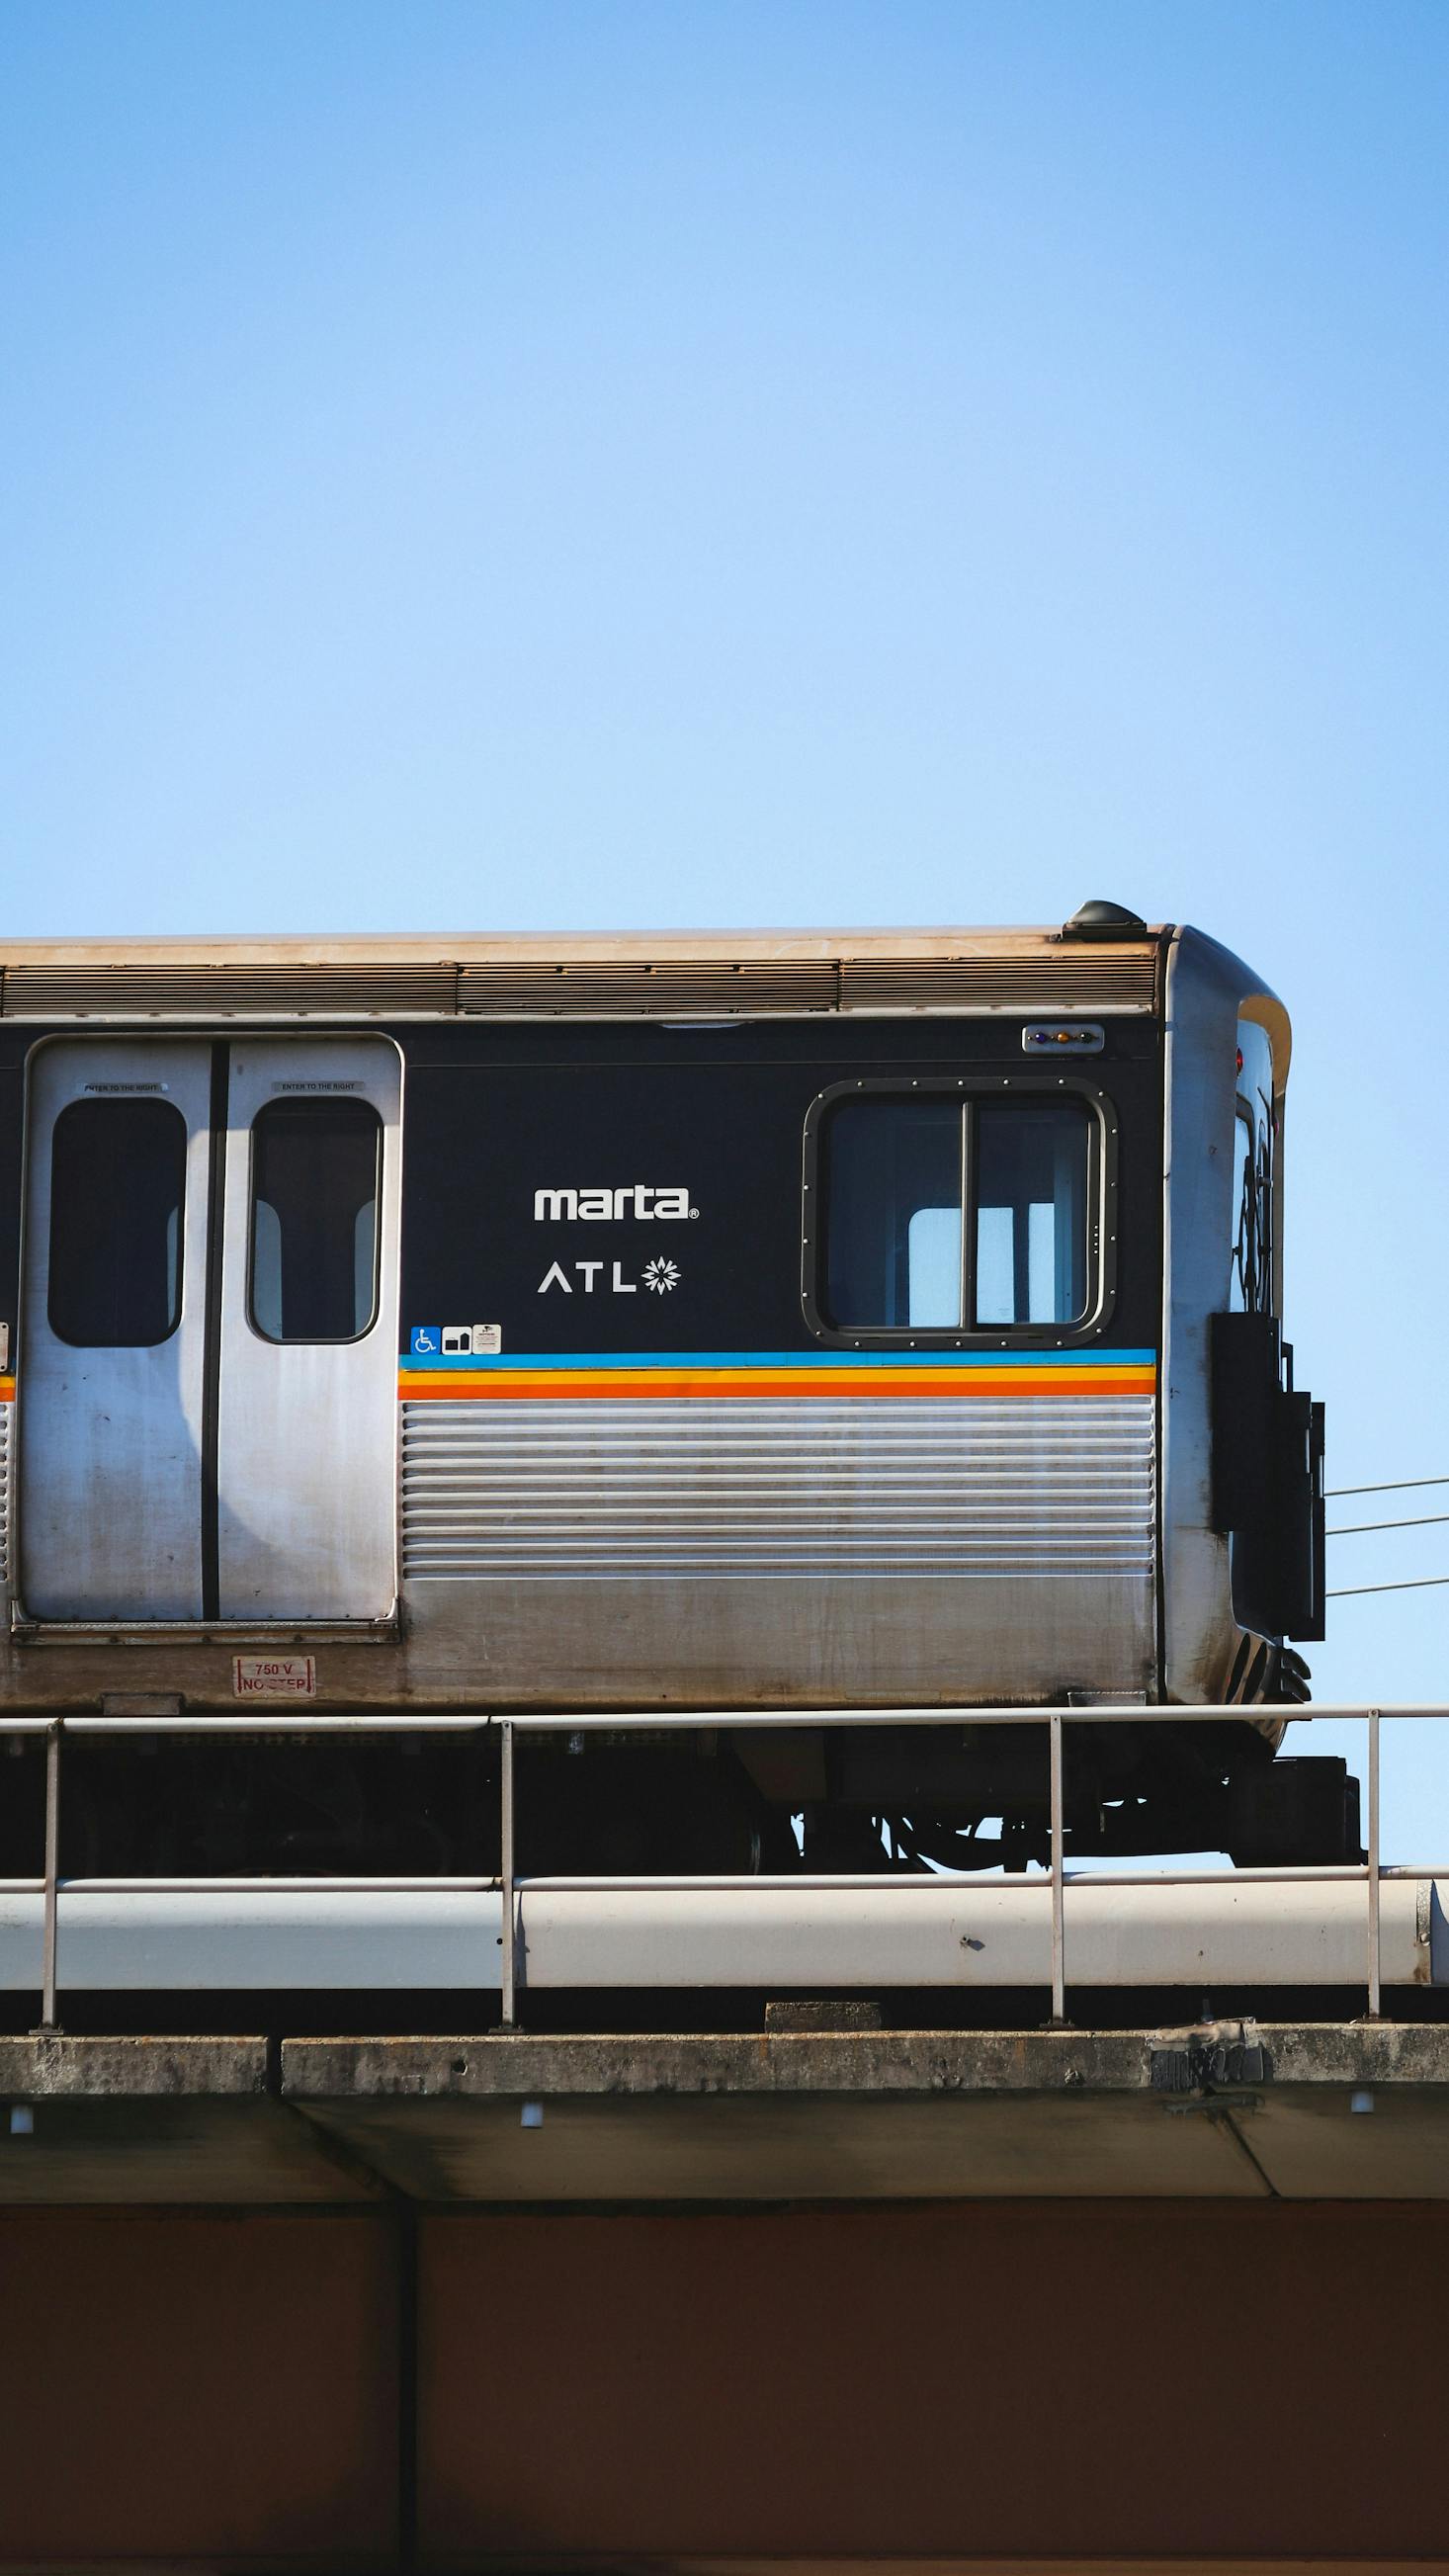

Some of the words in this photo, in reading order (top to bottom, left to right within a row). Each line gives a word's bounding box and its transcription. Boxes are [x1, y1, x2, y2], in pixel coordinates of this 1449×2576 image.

[538, 1261, 637, 1293] ATL
[256, 1665, 279, 1675] 750
[284, 1665, 293, 1674] V
[243, 1678, 264, 1690] NO
